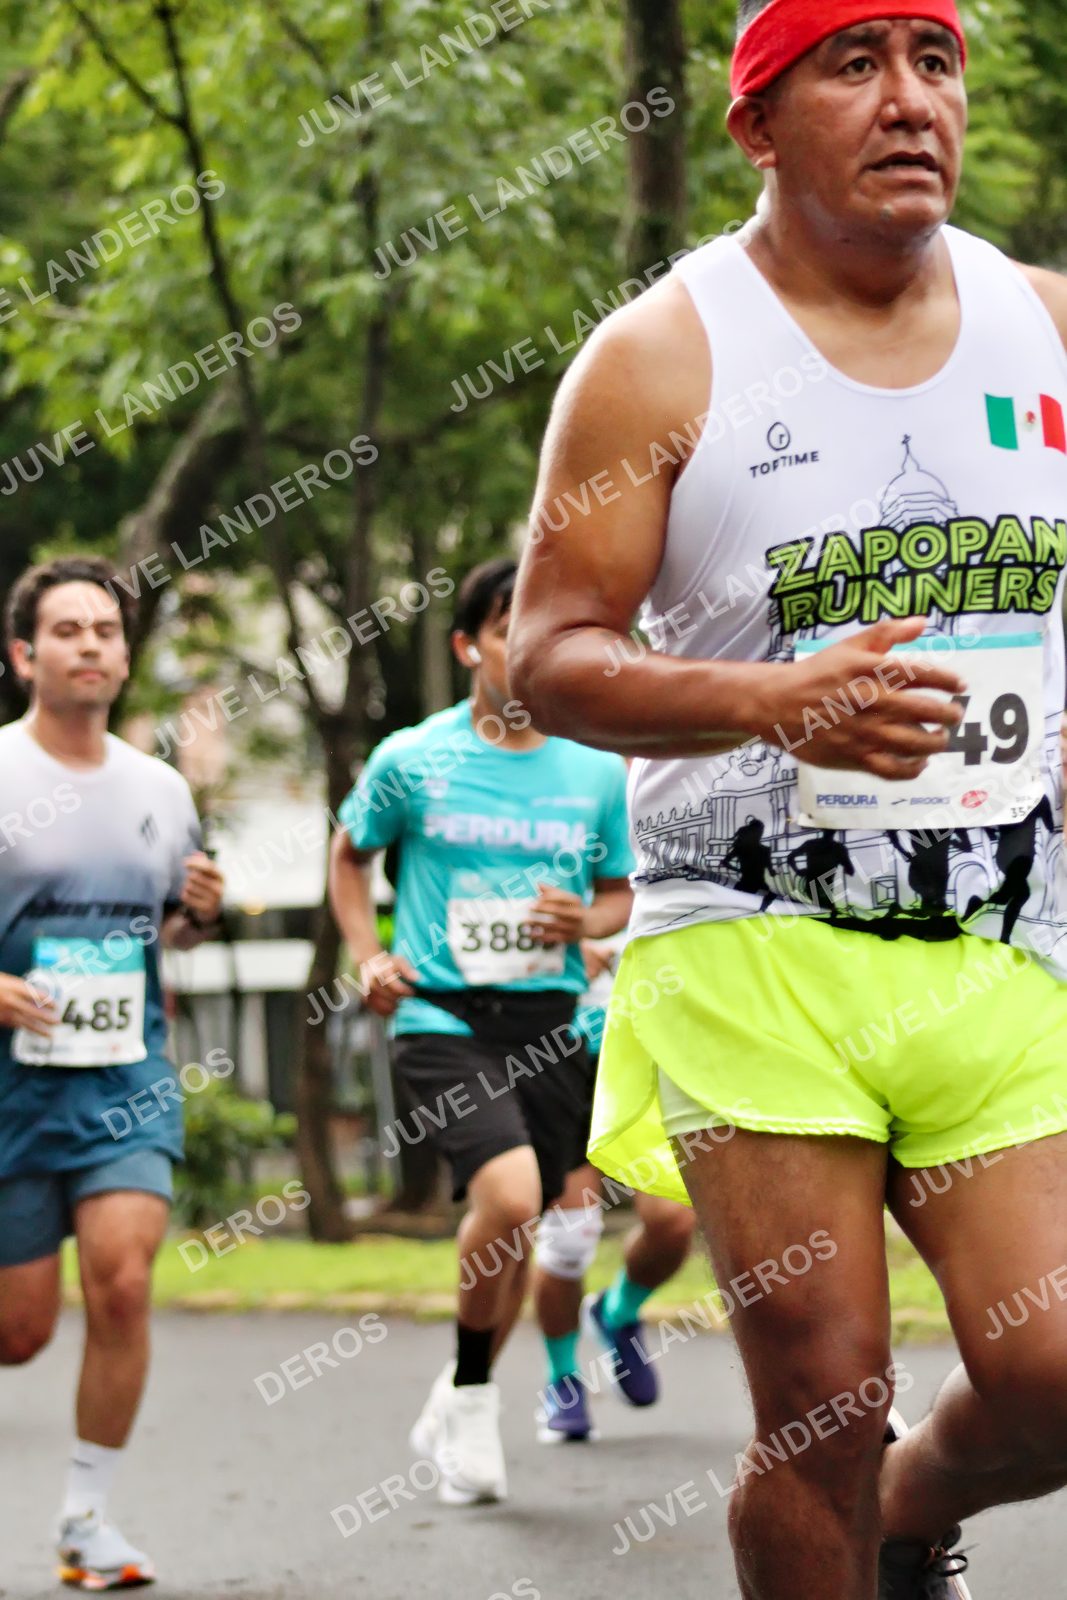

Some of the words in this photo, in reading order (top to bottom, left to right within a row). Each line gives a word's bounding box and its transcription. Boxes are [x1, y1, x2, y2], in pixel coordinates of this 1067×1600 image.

[766, 515, 1067, 597] ZAPOPAN
[778, 564, 1059, 633] RUNNERS
[815, 793, 879, 806] PERDURA
[423, 812, 590, 852] PERDURA
[460, 921, 557, 953] 388
